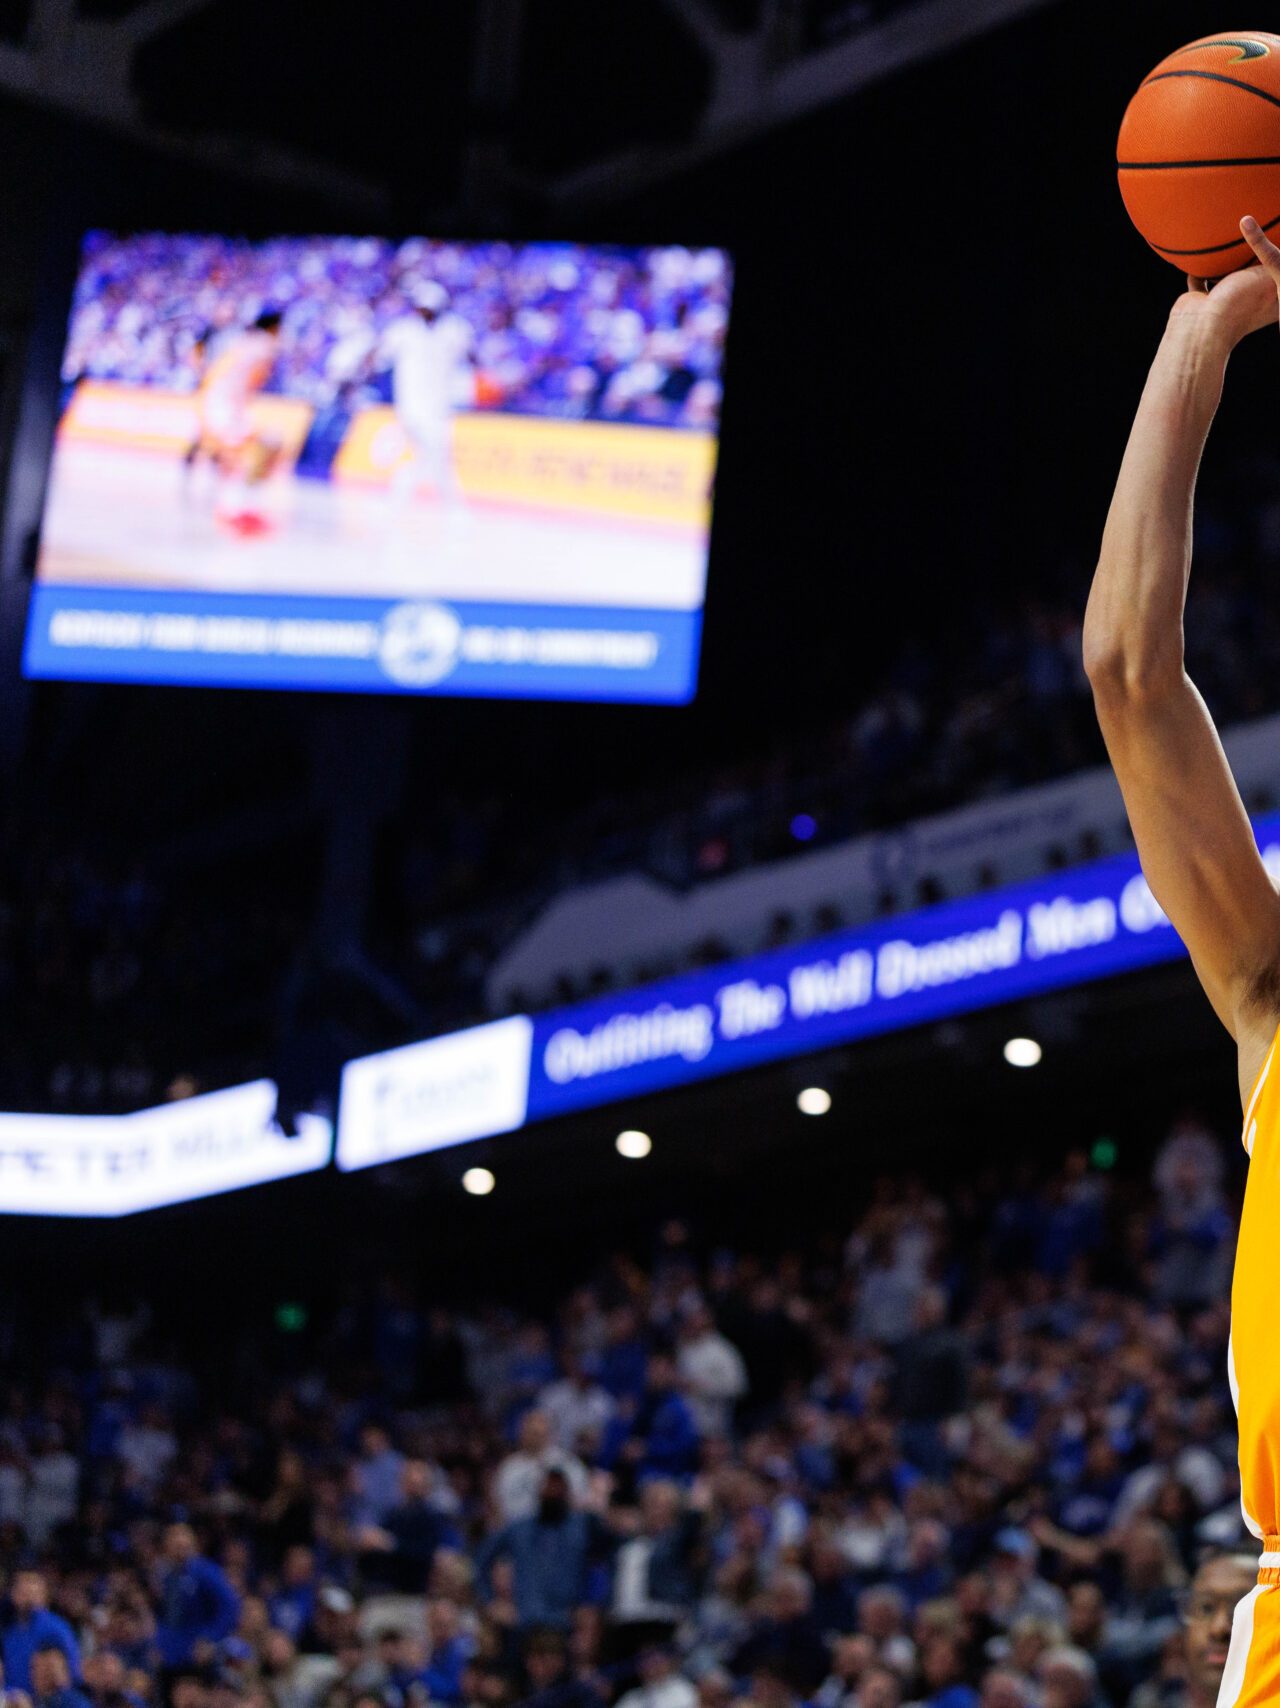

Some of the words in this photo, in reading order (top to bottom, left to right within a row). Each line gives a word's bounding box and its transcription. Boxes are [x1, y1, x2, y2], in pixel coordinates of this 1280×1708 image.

[543, 1001, 714, 1086] Outfitting
[715, 977, 787, 1041] The
[788, 947, 875, 1021] Well
[875, 907, 1023, 1000] Dressed
[1026, 895, 1117, 961] Men
